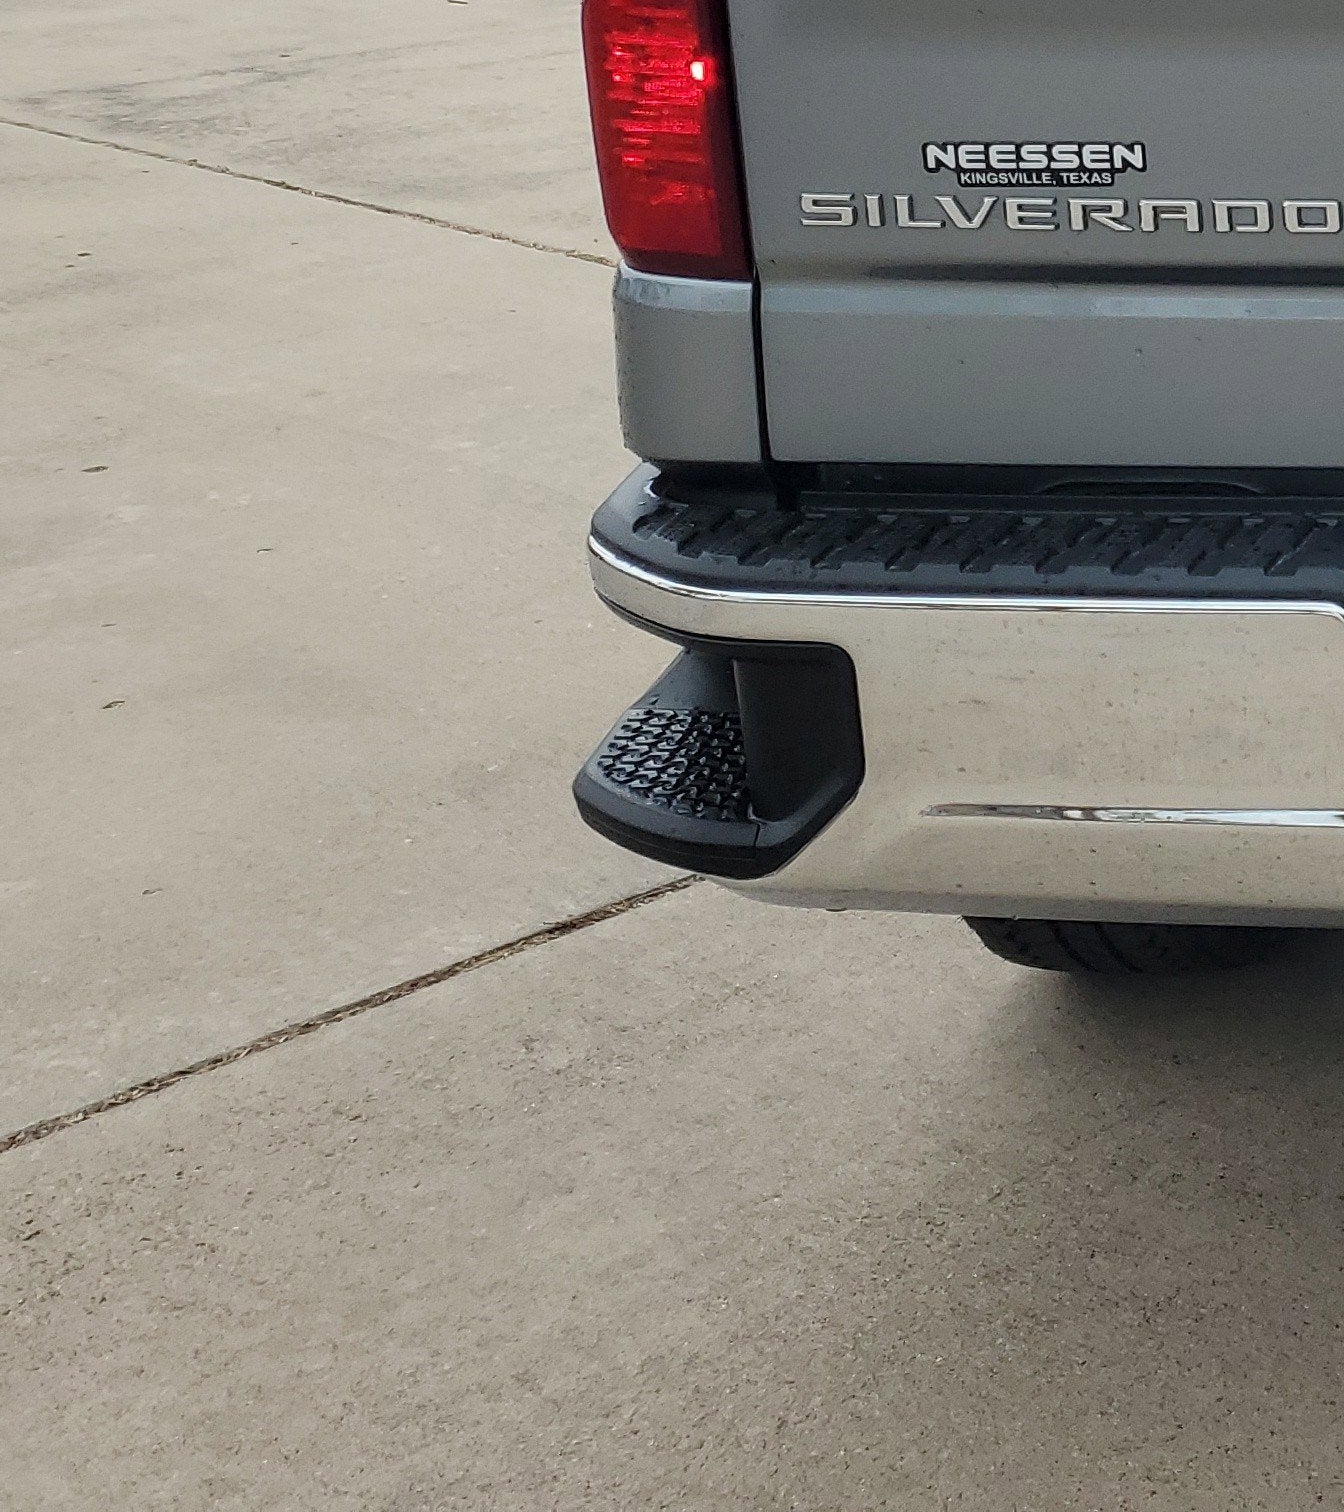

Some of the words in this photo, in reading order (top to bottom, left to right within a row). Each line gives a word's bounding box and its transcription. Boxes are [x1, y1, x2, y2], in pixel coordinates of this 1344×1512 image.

[925, 143, 1144, 170] NEESSEN
[960, 172, 1058, 186] KINGSVILLE,
[1060, 173, 1113, 185] TEXAS
[799, 192, 1343, 233] SILVERADO
